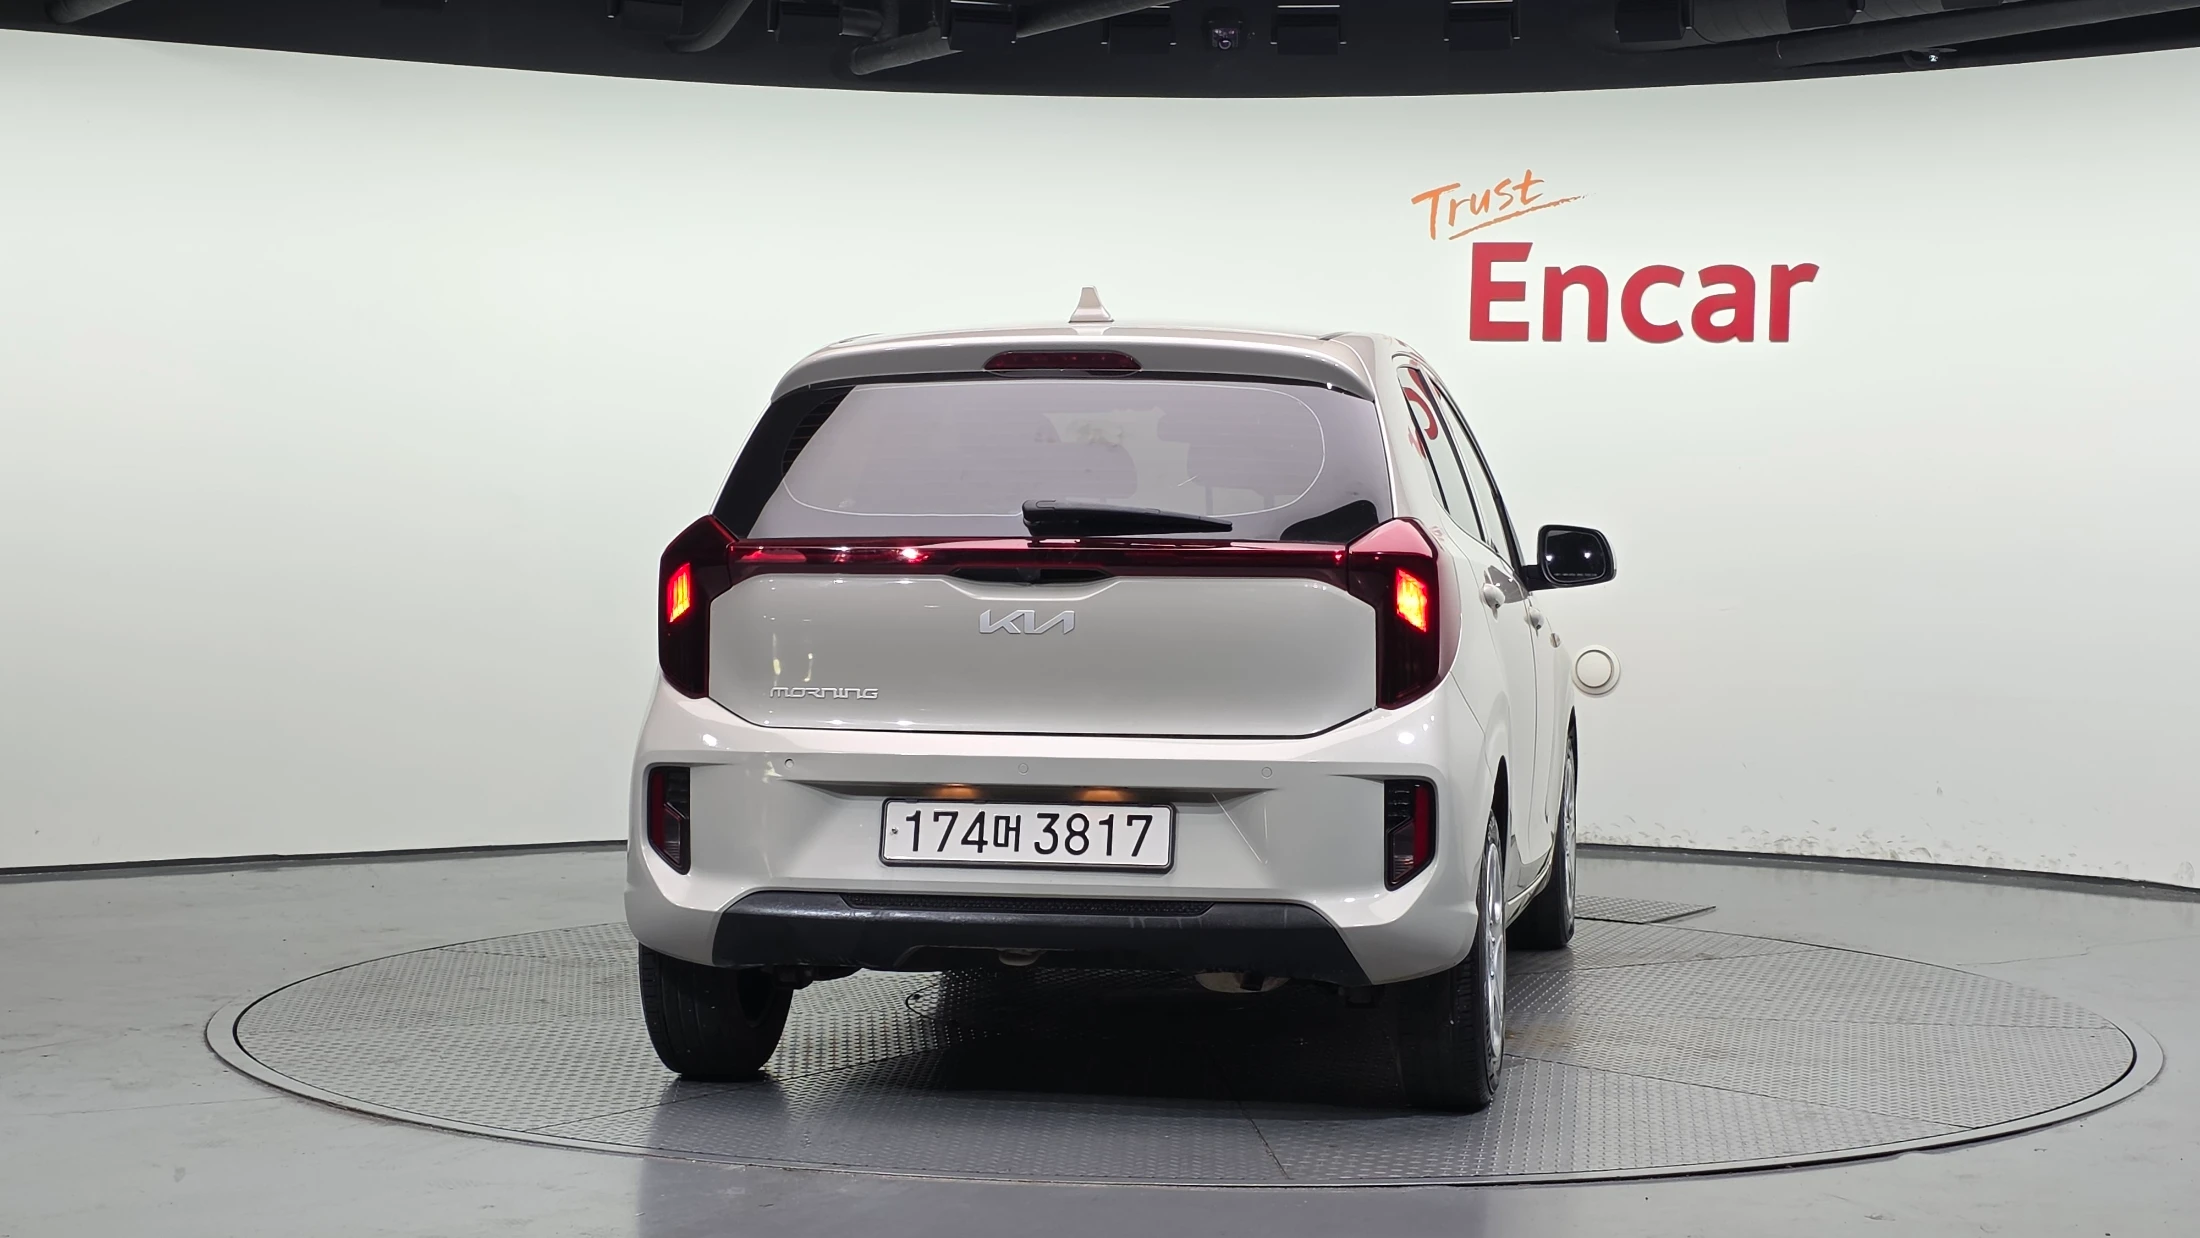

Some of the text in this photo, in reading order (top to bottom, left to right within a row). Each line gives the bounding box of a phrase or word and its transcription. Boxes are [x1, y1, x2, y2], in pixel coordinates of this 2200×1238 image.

[1411, 169, 1545, 241] Trust
[1469, 241, 1820, 344] Encar
[905, 809, 1154, 857] 174머 3817
